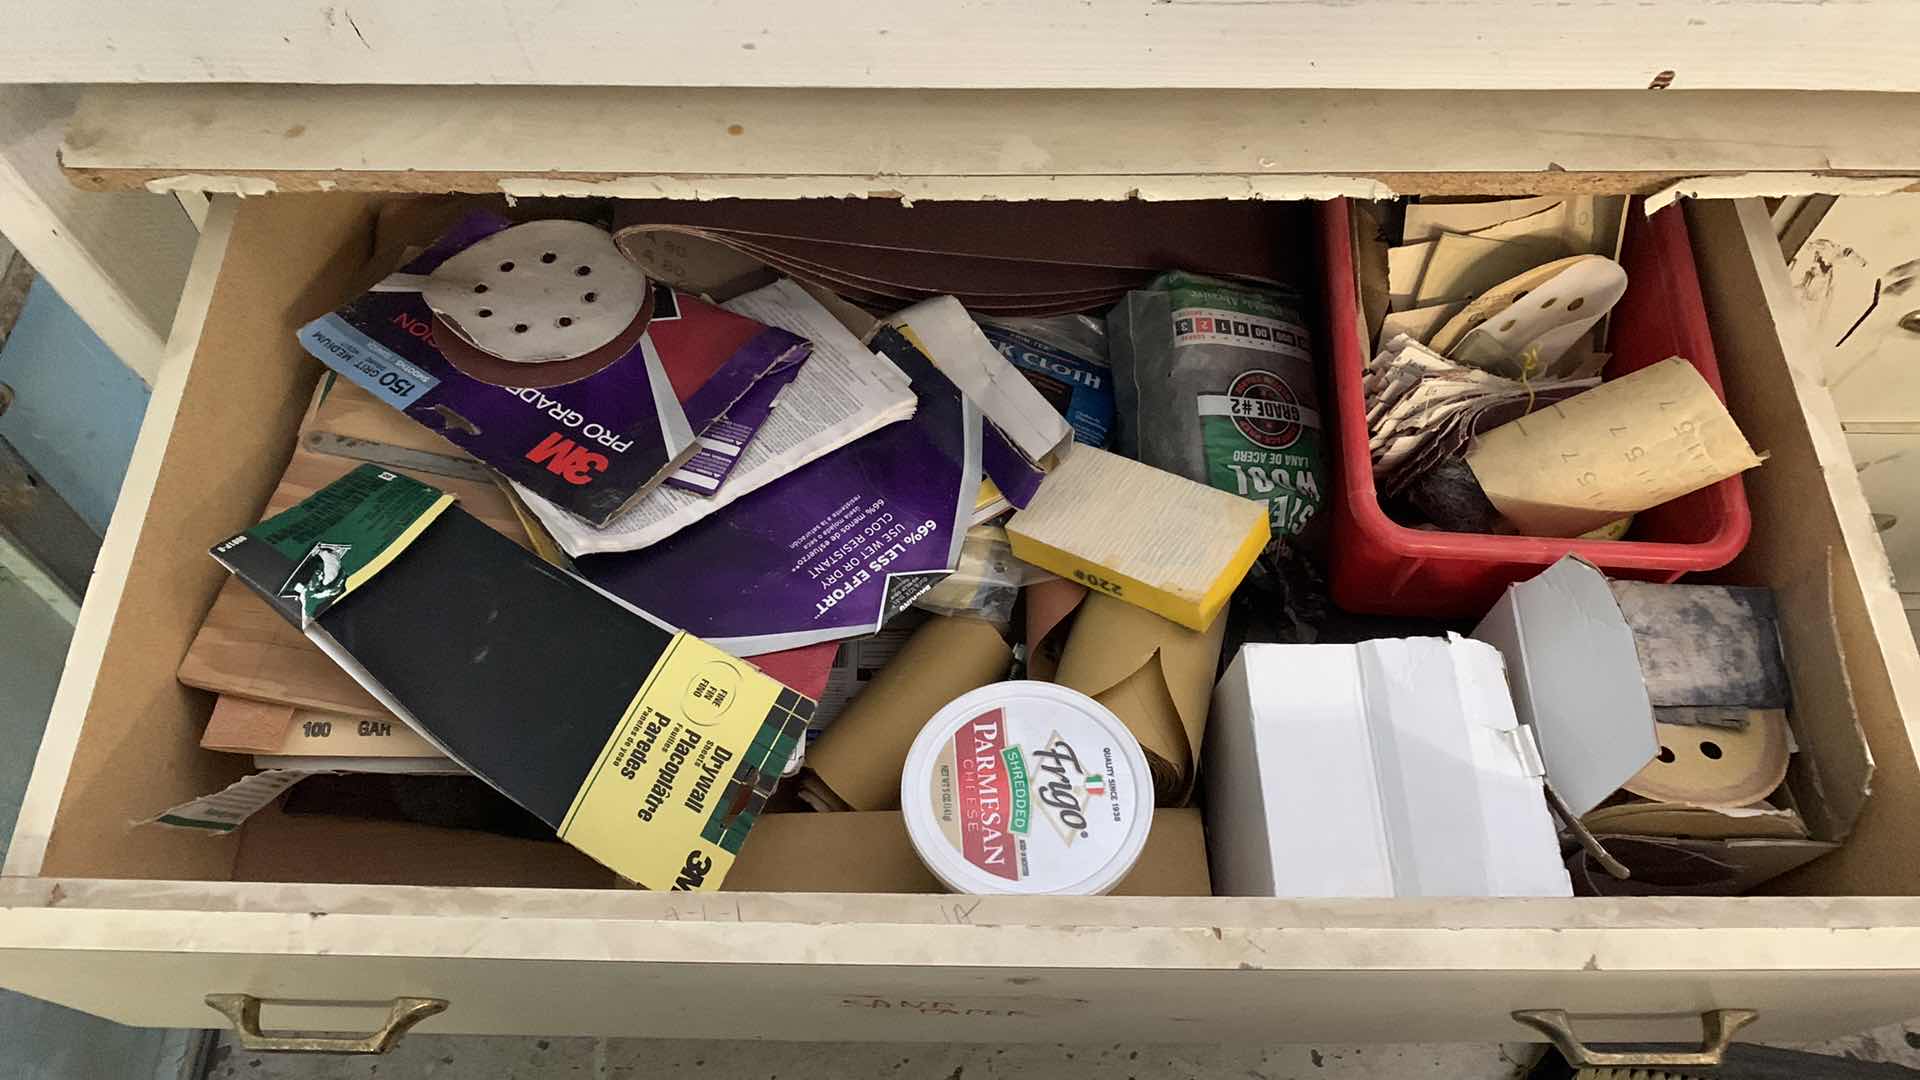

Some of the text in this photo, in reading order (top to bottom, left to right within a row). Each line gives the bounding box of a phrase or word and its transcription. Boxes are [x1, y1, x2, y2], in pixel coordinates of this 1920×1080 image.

[311, 330, 354, 363] MEDIUM
[352, 359, 380, 378] GRIT
[1023, 353, 1101, 390] CLOTH
[378, 372, 417, 398] 150
[1231, 397, 1301, 421] GRADE #2
[582, 422, 635, 453] PRO
[525, 431, 609, 486] 3M
[1232, 450, 1309, 468] LANA DE ACERO
[1227, 464, 1320, 502] WOOL
[865, 498, 885, 515] 66%
[831, 531, 841, 542] de
[840, 513, 866, 534] menos
[903, 519, 937, 545] 66%
[808, 512, 894, 580] CLOG RESISTANT
[820, 523, 906, 591] USE WET OR DRY
[869, 542, 907, 572] LESS
[693, 678, 709, 698] FINO
[704, 684, 718, 701] FIN
[711, 689, 728, 708] FINE
[303, 721, 331, 738] 100
[624, 737, 634, 747] de
[613, 747, 628, 767] yeso
[621, 711, 672, 780] Paredes
[694, 740, 715, 767] Sheets
[637, 728, 702, 823] Placoplâtre
[941, 765, 950, 777] NET
[1103, 747, 1115, 777] QUALITY
[685, 745, 733, 814] Drywall
[1005, 751, 1030, 829] SHREDDED
[1108, 778, 1118, 801] SINCE
[963, 759, 980, 833] CHEESE
[972, 721, 1006, 866] PARMESAN
[670, 849, 713, 891] 3M
